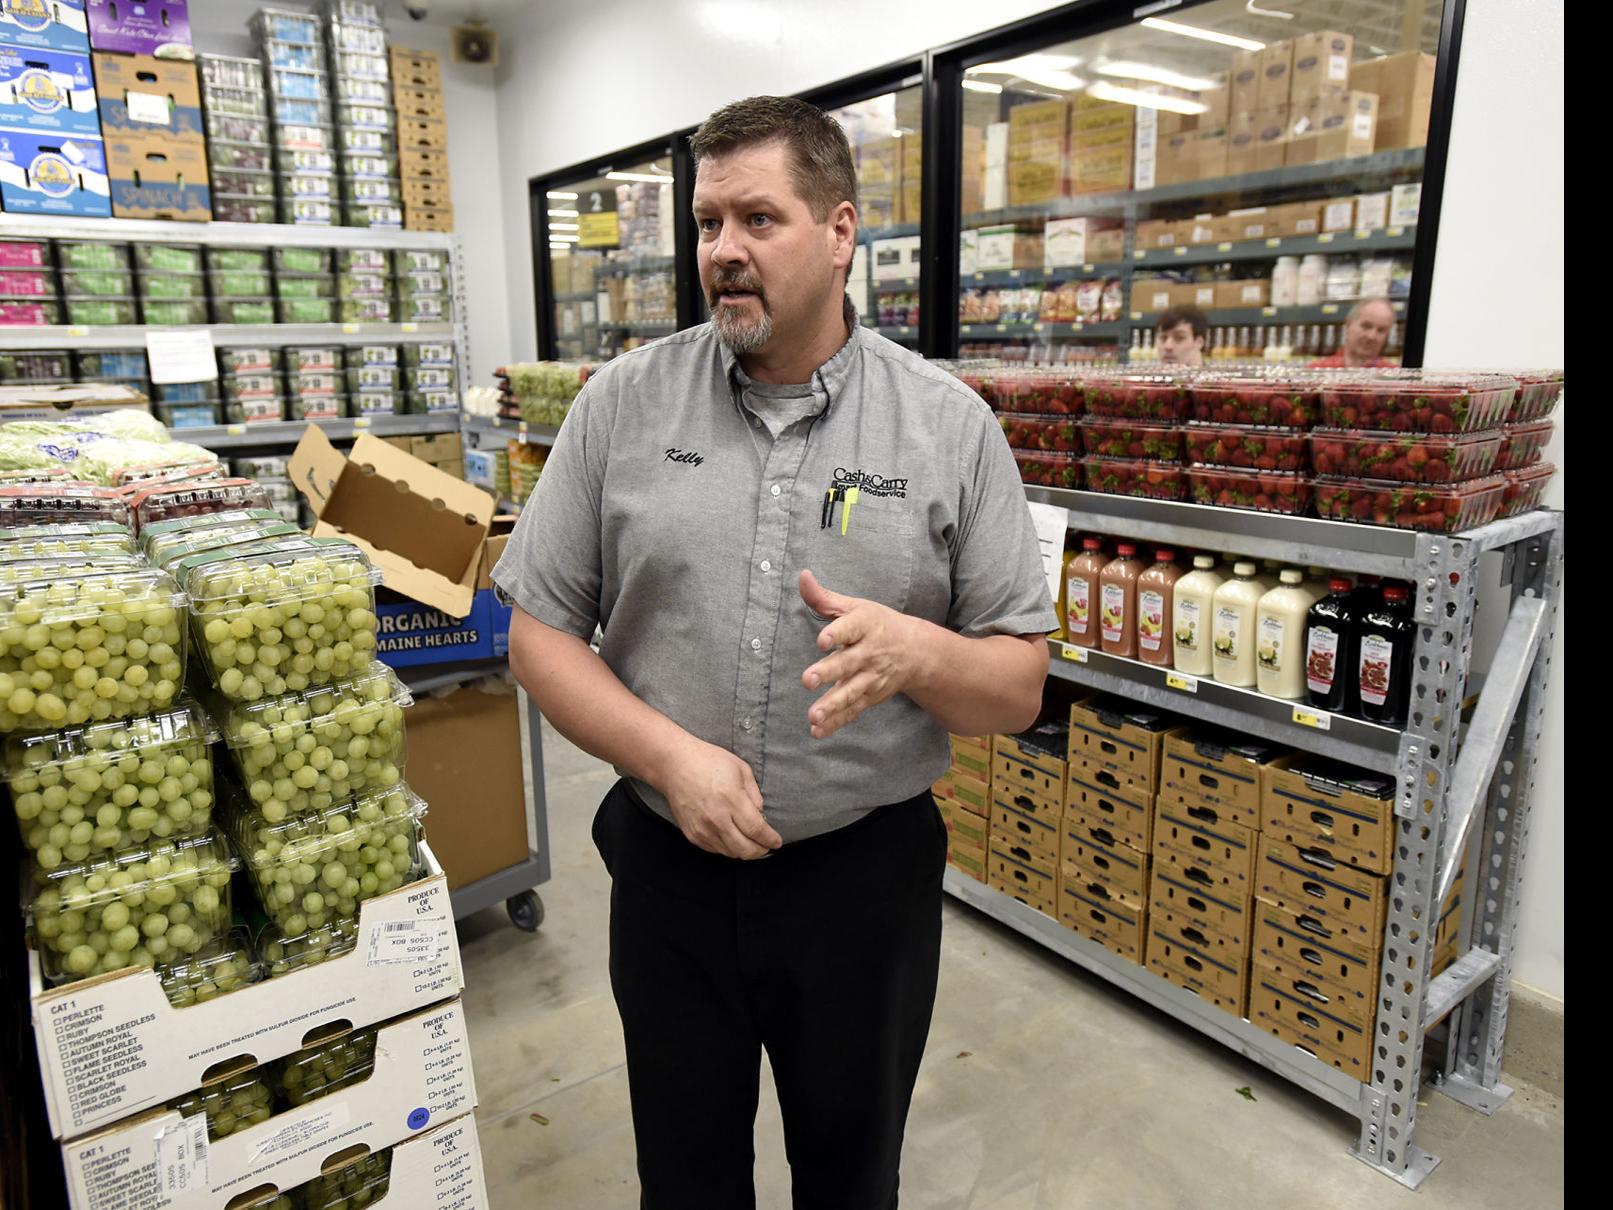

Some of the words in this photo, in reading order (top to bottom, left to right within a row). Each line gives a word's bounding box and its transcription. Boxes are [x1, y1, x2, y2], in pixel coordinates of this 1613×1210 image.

[590, 192, 602, 212] 2
[664, 448, 704, 467] Kelly
[425, 630, 478, 646] HEARTS
[407, 887, 440, 903] PRODUCE
[420, 898, 429, 906] OF
[50, 1003, 68, 1015] CAT
[70, 1000, 77, 1009] 1
[62, 1004, 104, 1024] PERLETTE
[64, 1014, 102, 1031] CRIMSON
[422, 1011, 454, 1029] PRODUCE
[434, 1022, 444, 1031] OF
[66, 1027, 89, 1040] RUBY
[68, 1028, 114, 1049] THOMPSON
[115, 1013, 156, 1033] SEEDLESS
[201, 1047, 215, 1056] HAVE
[216, 1041, 230, 1050] BEEN
[231, 1033, 254, 1044] TREATED
[255, 1028, 268, 1036] WITH
[269, 1020, 288, 1031] SULFUR
[70, 1041, 105, 1058] AUTUMN
[106, 1031, 133, 1045] ROYAL
[72, 1051, 99, 1066] SWEET
[101, 1037, 138, 1055] SCARLET
[73, 1059, 101, 1074] FLAME
[102, 1044, 143, 1064] SEEDLESS
[75, 1064, 112, 1082] SCARLET
[114, 1055, 140, 1069] ROYAL
[76, 1075, 105, 1090] BLACK
[106, 1060, 147, 1079] SEEDLESS
[78, 1081, 116, 1099] CRIMSON
[80, 1095, 98, 1107] RED
[99, 1085, 127, 1100] GLOBE
[82, 1095, 122, 1116] PRINCESS
[433, 1127, 464, 1147] PRODUCE
[444, 1138, 454, 1148] OF
[80, 1148, 96, 1160] CAT
[99, 1145, 105, 1153] 1
[90, 1147, 131, 1168] PERLETTE
[177, 1144, 185, 1160] BOX
[92, 1157, 129, 1176] CRIMSON
[211, 1184, 223, 1193] MAY
[223, 1178, 237, 1188] HAVE
[237, 1172, 252, 1182] BEEN
[252, 1163, 275, 1175] TREATED
[276, 1157, 288, 1165] WITH
[289, 1149, 308, 1160] SULFUR
[328, 1136, 338, 1144] FOR
[94, 1170, 116, 1184] RUBY
[96, 1169, 140, 1191] THOMPSON
[98, 1181, 131, 1199] AUTUMN
[132, 1171, 157, 1186] ROYAL
[100, 1191, 126, 1207] SWEET
